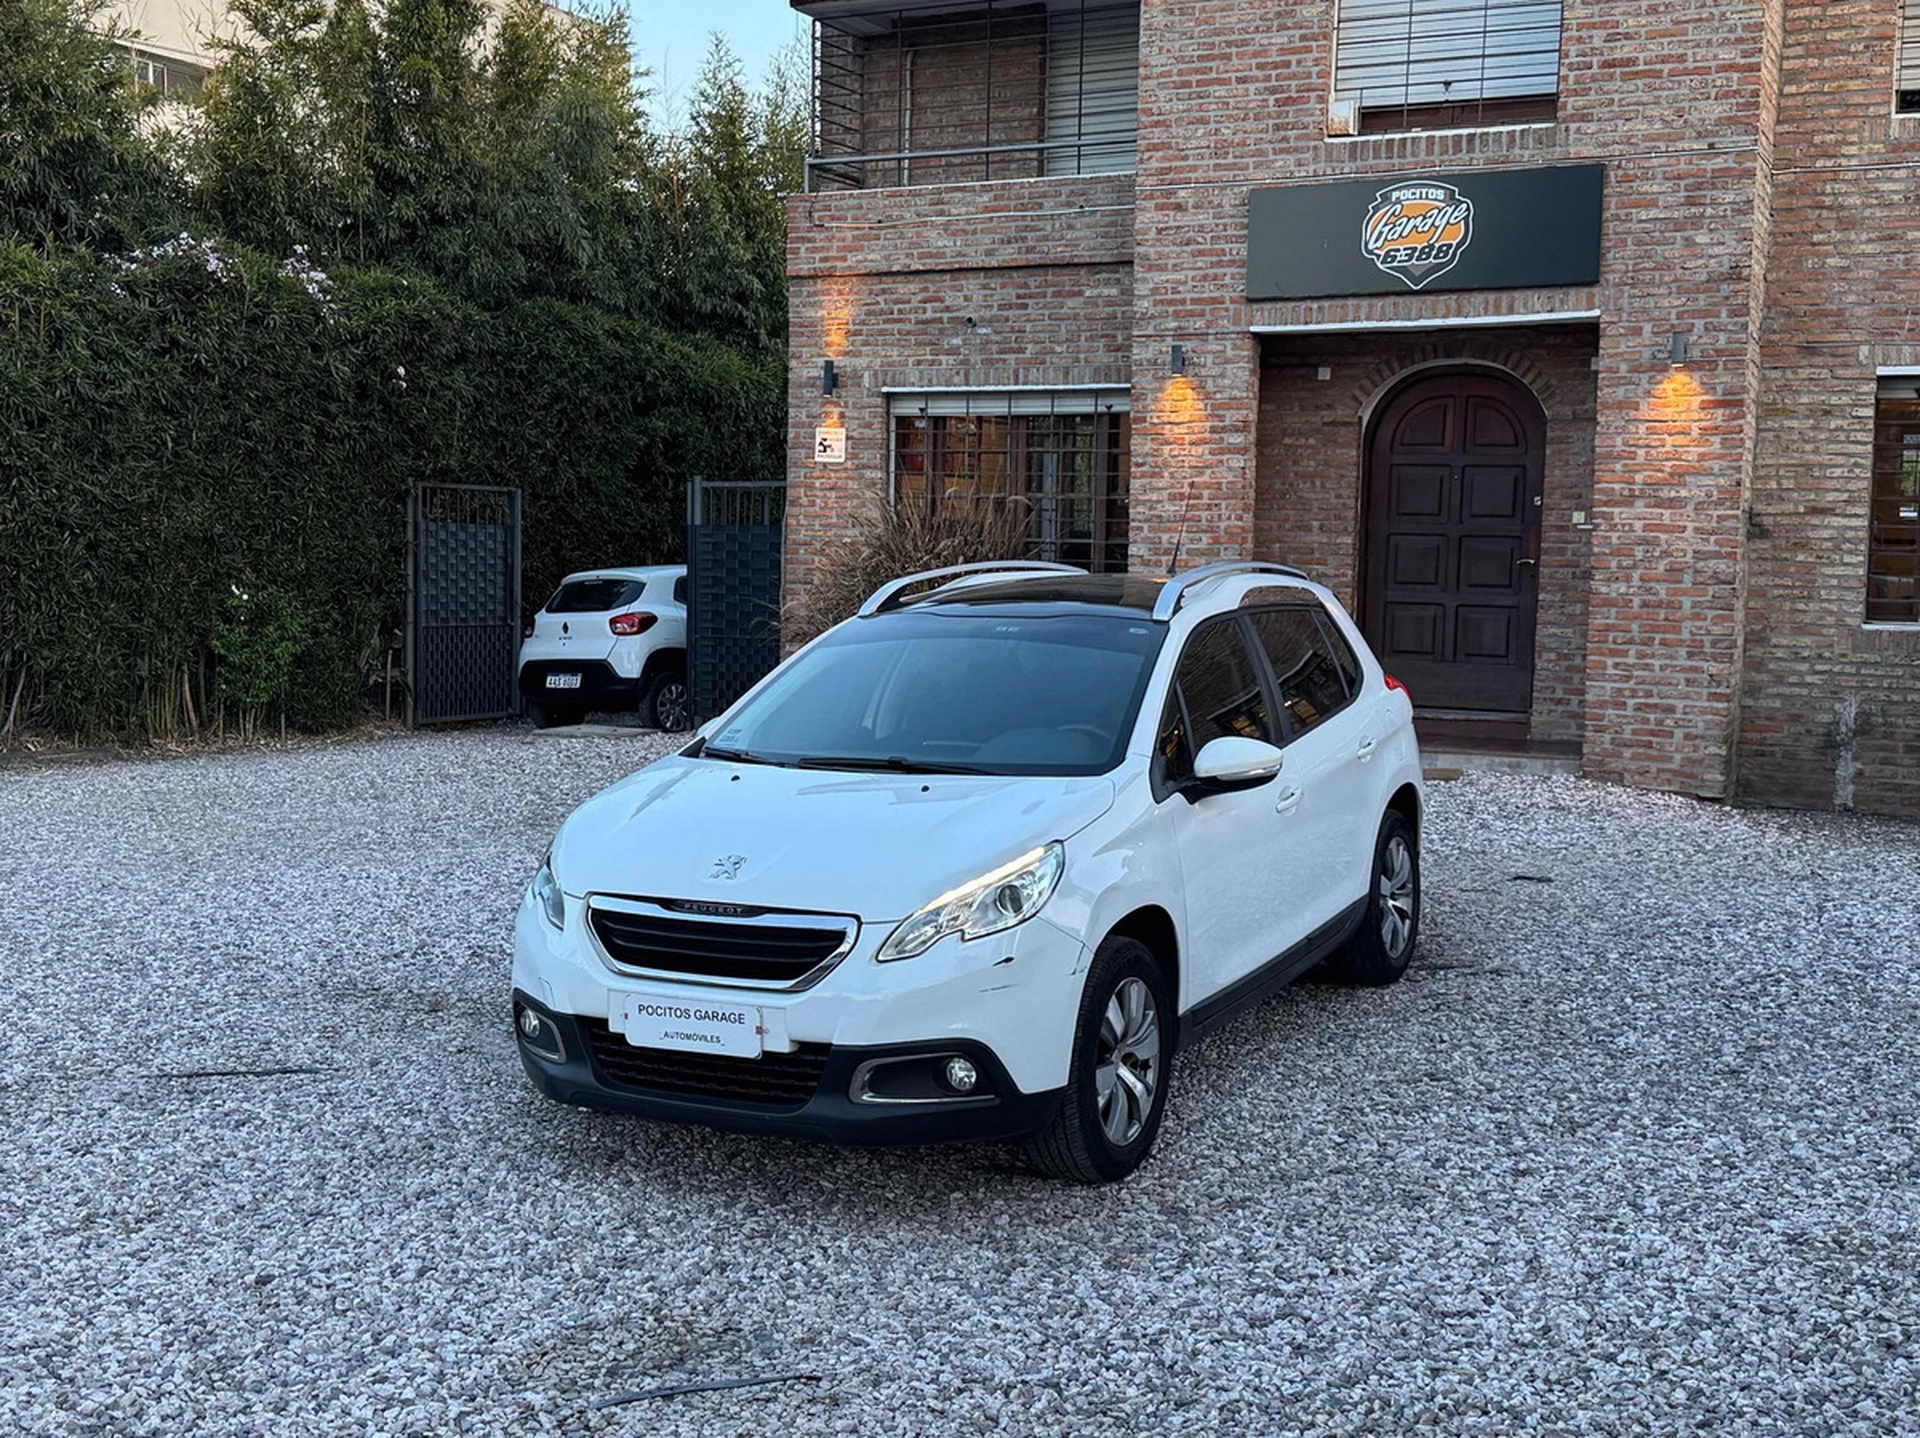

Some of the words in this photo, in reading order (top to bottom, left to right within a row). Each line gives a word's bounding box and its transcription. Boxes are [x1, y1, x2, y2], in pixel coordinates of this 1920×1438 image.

[1391, 188, 1445, 202] POCITOS
[1367, 203, 1469, 250] Garage
[1381, 243, 1454, 265] 6388
[683, 903, 743, 914] PEUGEOT
[637, 1003, 691, 1020] POCITOS
[693, 1008, 746, 1025] GARAGE
